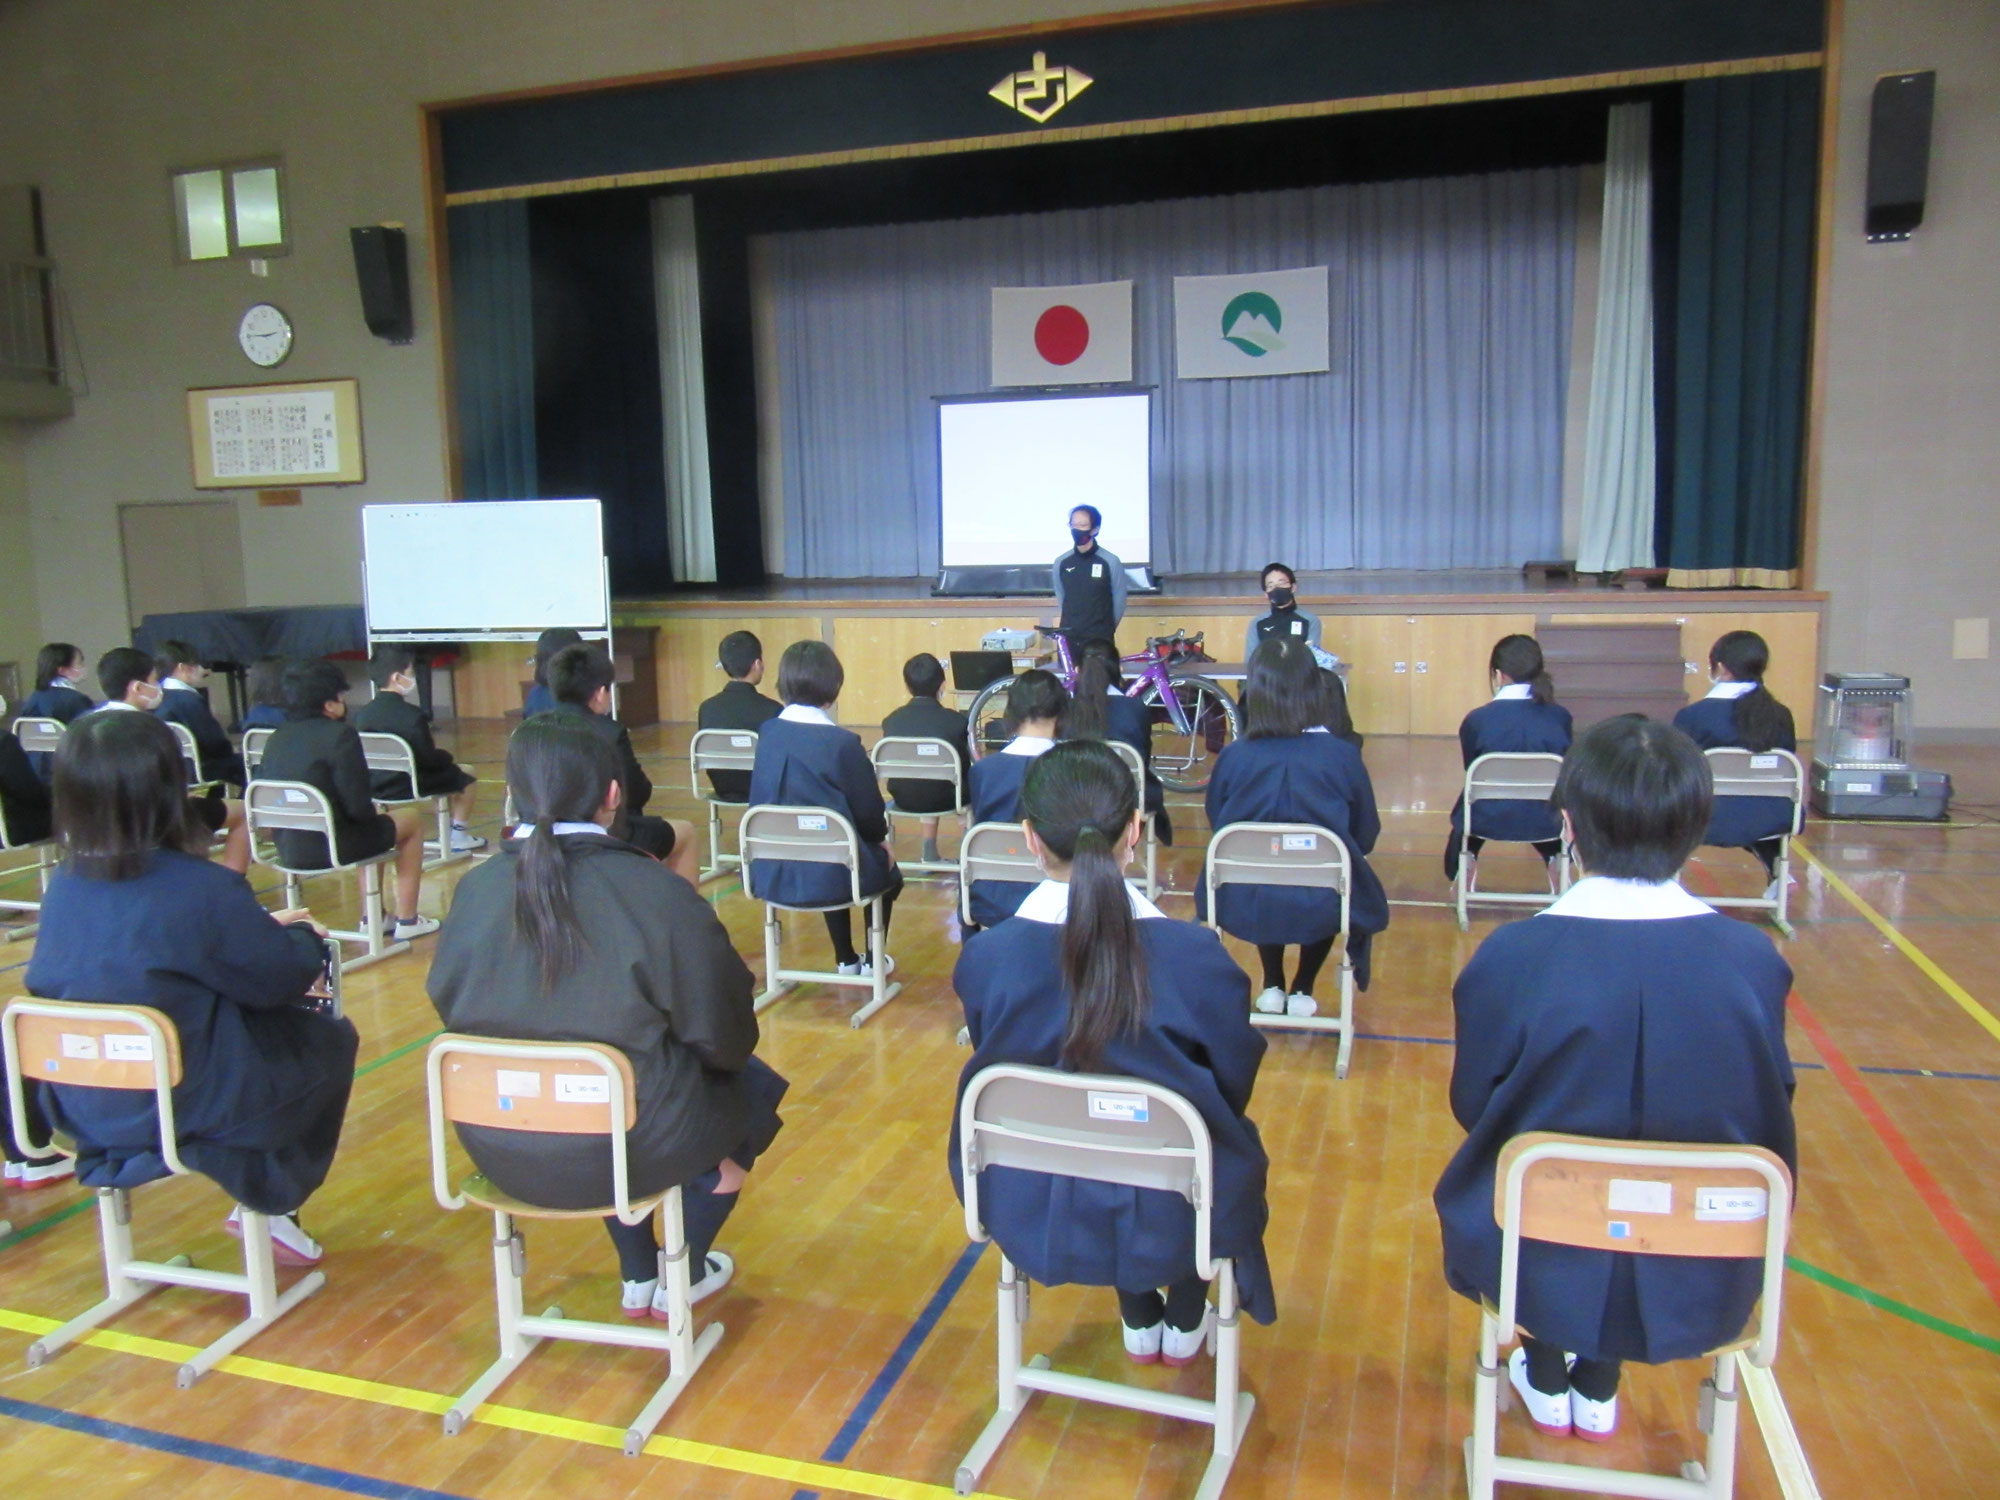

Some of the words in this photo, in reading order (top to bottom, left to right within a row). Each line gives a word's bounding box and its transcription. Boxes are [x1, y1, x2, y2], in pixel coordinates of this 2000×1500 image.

[112, 1043, 119, 1052] L
[564, 1083, 571, 1094] L
[1098, 1100, 1106, 1111] L
[1708, 1198, 1717, 1210] L
